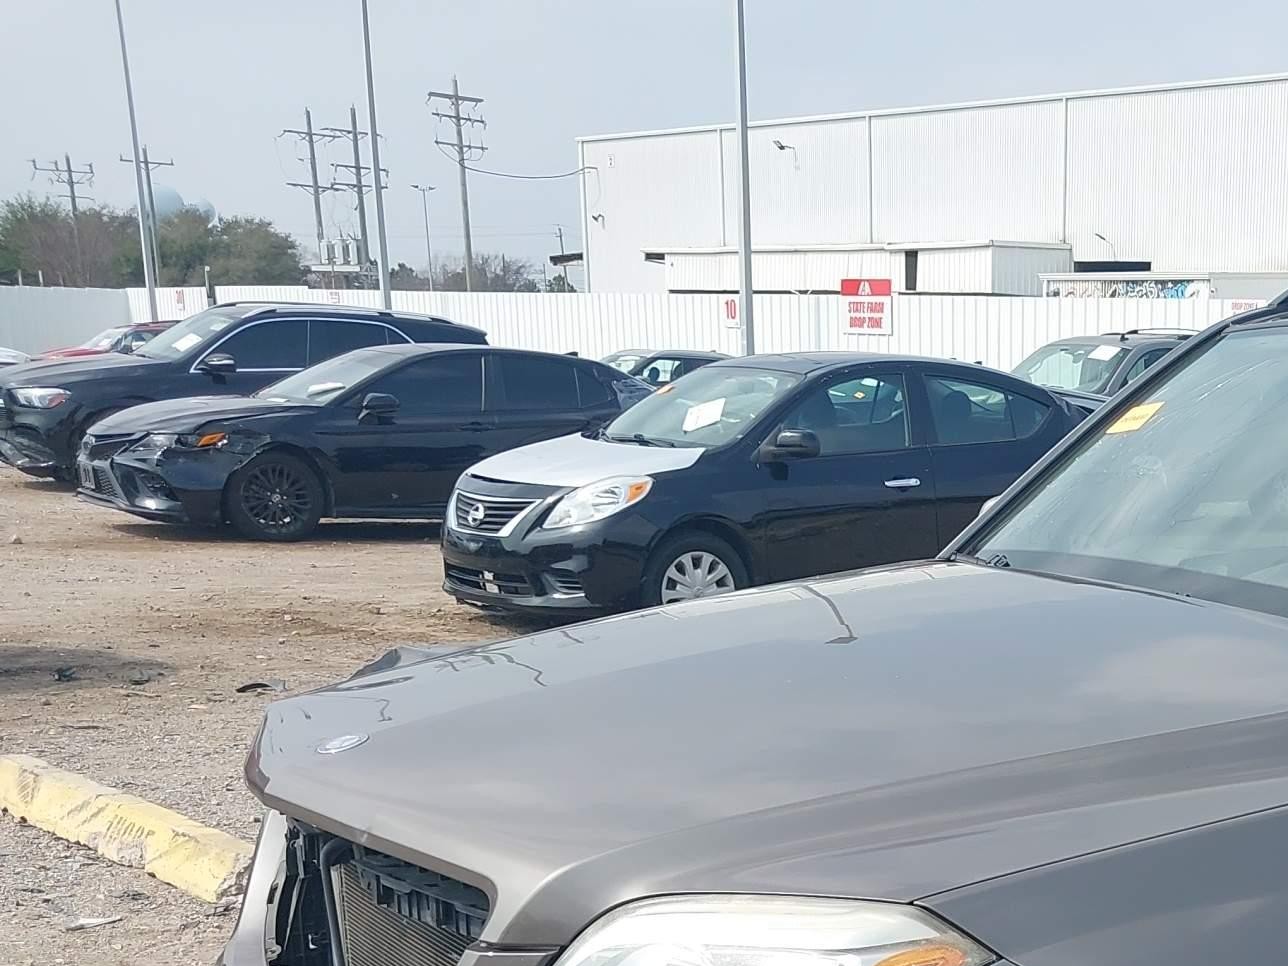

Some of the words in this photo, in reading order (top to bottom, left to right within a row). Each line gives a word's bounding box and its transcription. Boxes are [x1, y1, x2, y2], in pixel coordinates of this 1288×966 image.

[724, 298, 737, 320] 10
[847, 301, 866, 314] STATE
[866, 301, 885, 314] FARM
[849, 316, 867, 329] DROP
[867, 316, 884, 329] ZONE
